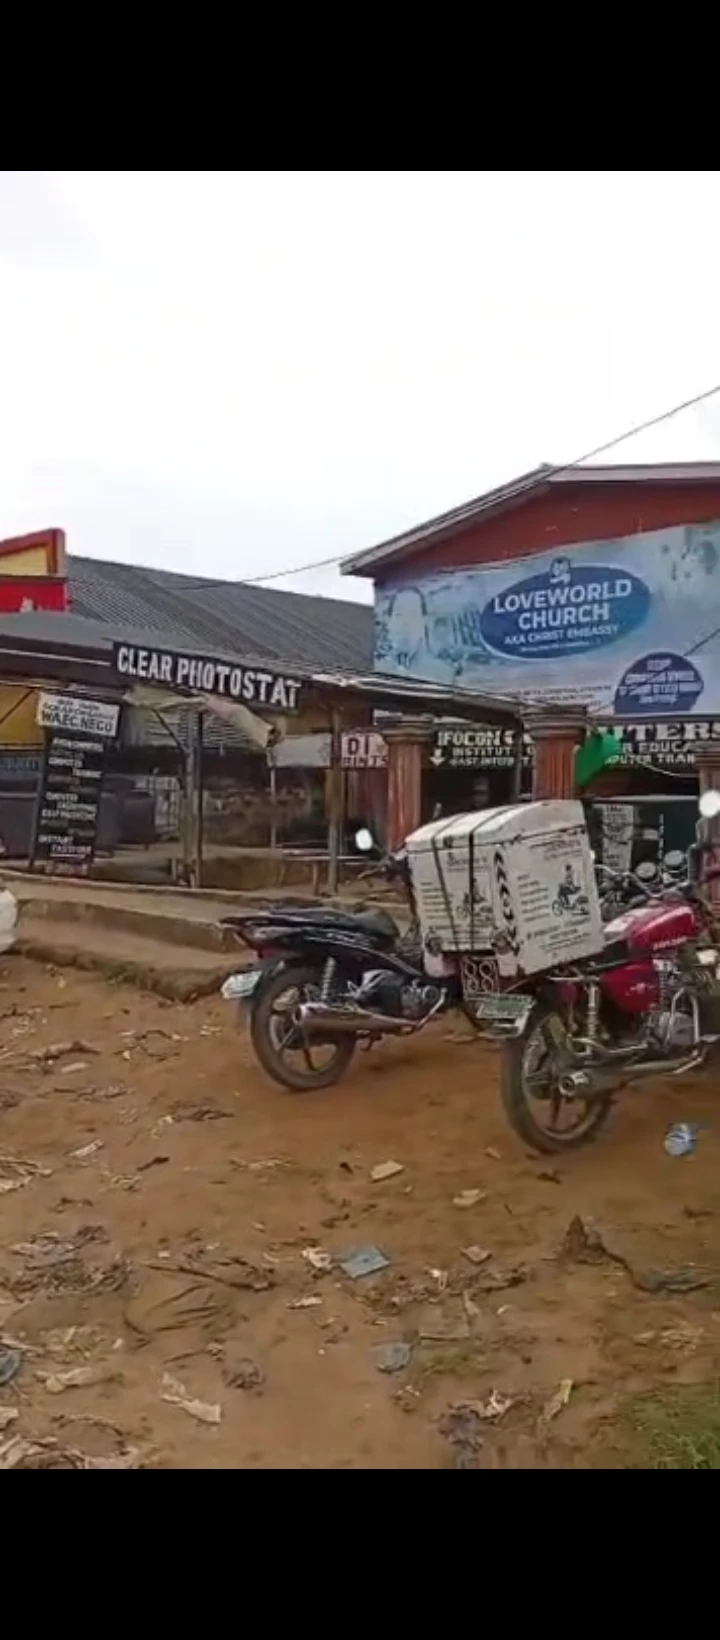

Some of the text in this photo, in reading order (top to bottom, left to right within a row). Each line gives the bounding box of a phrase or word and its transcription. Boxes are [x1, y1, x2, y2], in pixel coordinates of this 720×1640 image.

[493, 578, 632, 614] LOVEWORLD
[518, 602, 610, 630] CHURCH
[504, 624, 618, 645] AKA CHRIST EMBASSY
[117, 646, 301, 708] CLEAR PHOTOSTAT
